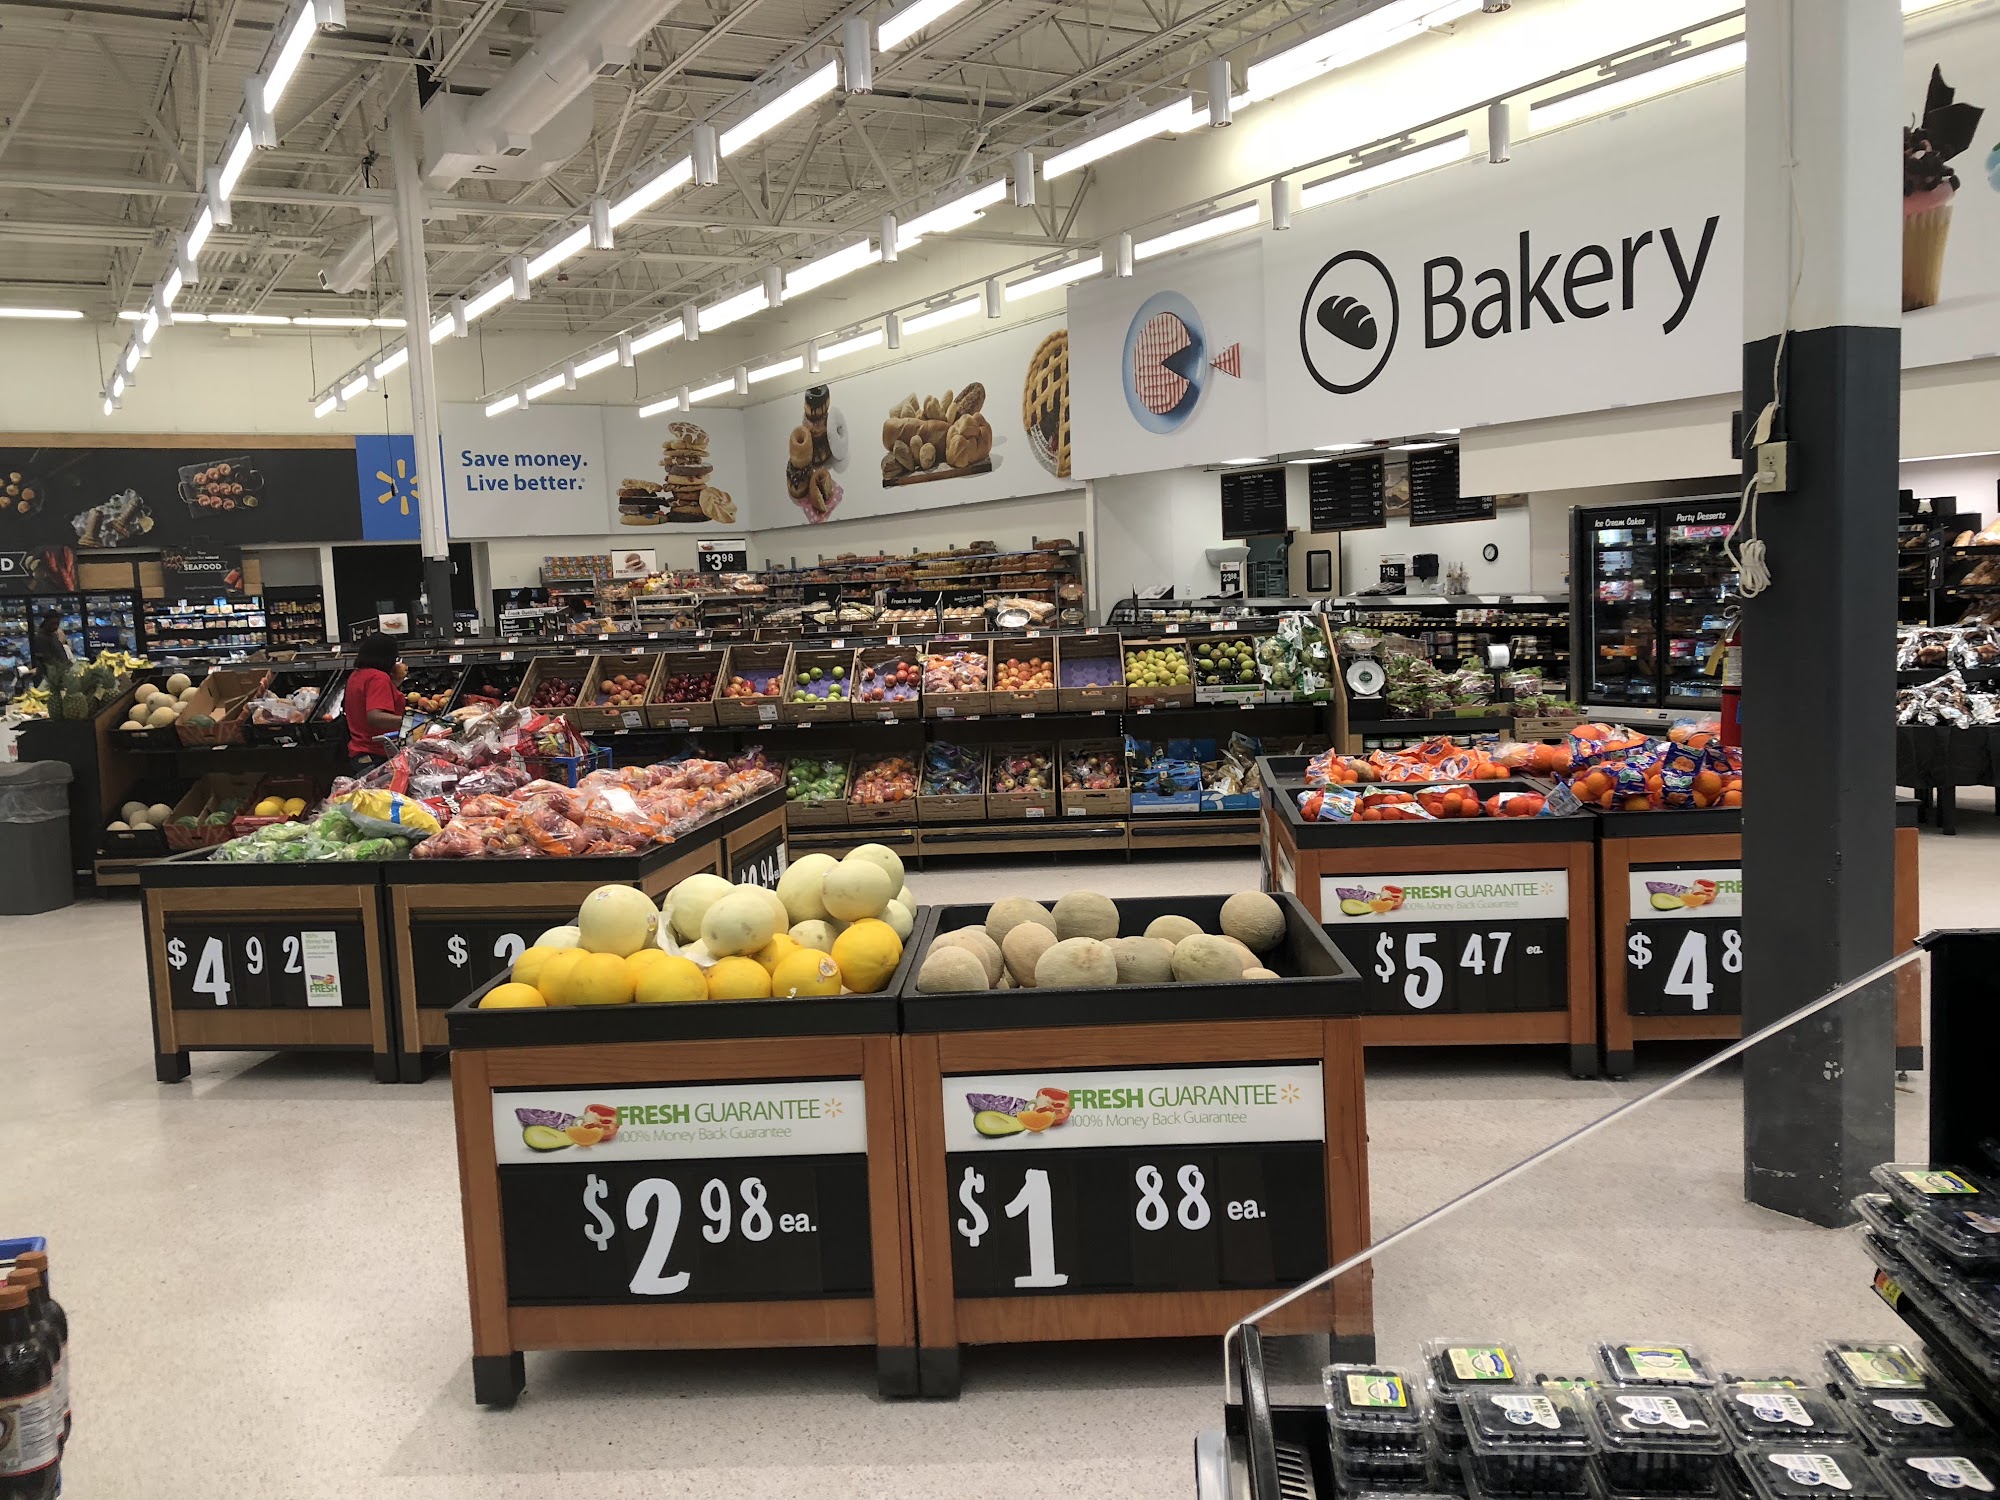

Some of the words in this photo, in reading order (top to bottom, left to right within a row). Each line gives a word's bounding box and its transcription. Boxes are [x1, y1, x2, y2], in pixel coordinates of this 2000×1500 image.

[1423, 215, 1721, 349] Bakery
[461, 450, 509, 467] Save
[515, 454, 588, 471] money.
[466, 474, 509, 491] Live
[514, 473, 584, 491] better.
[1594, 520, 1604, 528] Ice
[1604, 519, 1625, 527] Cream
[1626, 517, 1646, 526] Cakes
[1676, 513, 1695, 523] Party
[1696, 512, 1726, 521] Desserts
[184, 563, 222, 571] SEAFOOD
[1402, 886, 1452, 899] FRESH
[1454, 882, 1539, 898] GUARANTEE
[1426, 902, 1454, 911] Money
[1456, 901, 1476, 909] Back
[1477, 900, 1518, 908] Guarantee
[1460, 932, 1512, 975] 47
[1526, 943, 1543, 955] ea.
[1069, 1088, 1144, 1110] FRESH
[1149, 1085, 1277, 1107] GUARANTEE
[616, 1104, 690, 1125] FRESH
[695, 1099, 821, 1123] GUARANTEE
[1070, 1114, 1102, 1128] 100%
[1107, 1115, 1149, 1130] Money
[1153, 1112, 1181, 1126] Back
[1184, 1111, 1247, 1124] Guarantee
[618, 1129, 650, 1143] 100%
[653, 1129, 696, 1143] Money
[700, 1127, 727, 1140] Back
[730, 1126, 792, 1139] Guarantee
[1135, 1164, 1211, 1231] 88
[1227, 1199, 1266, 1221] ea.
[700, 1177, 774, 1244] 98
[780, 1211, 817, 1233] ea.
[1532, 1398, 1552, 1418] MARK
